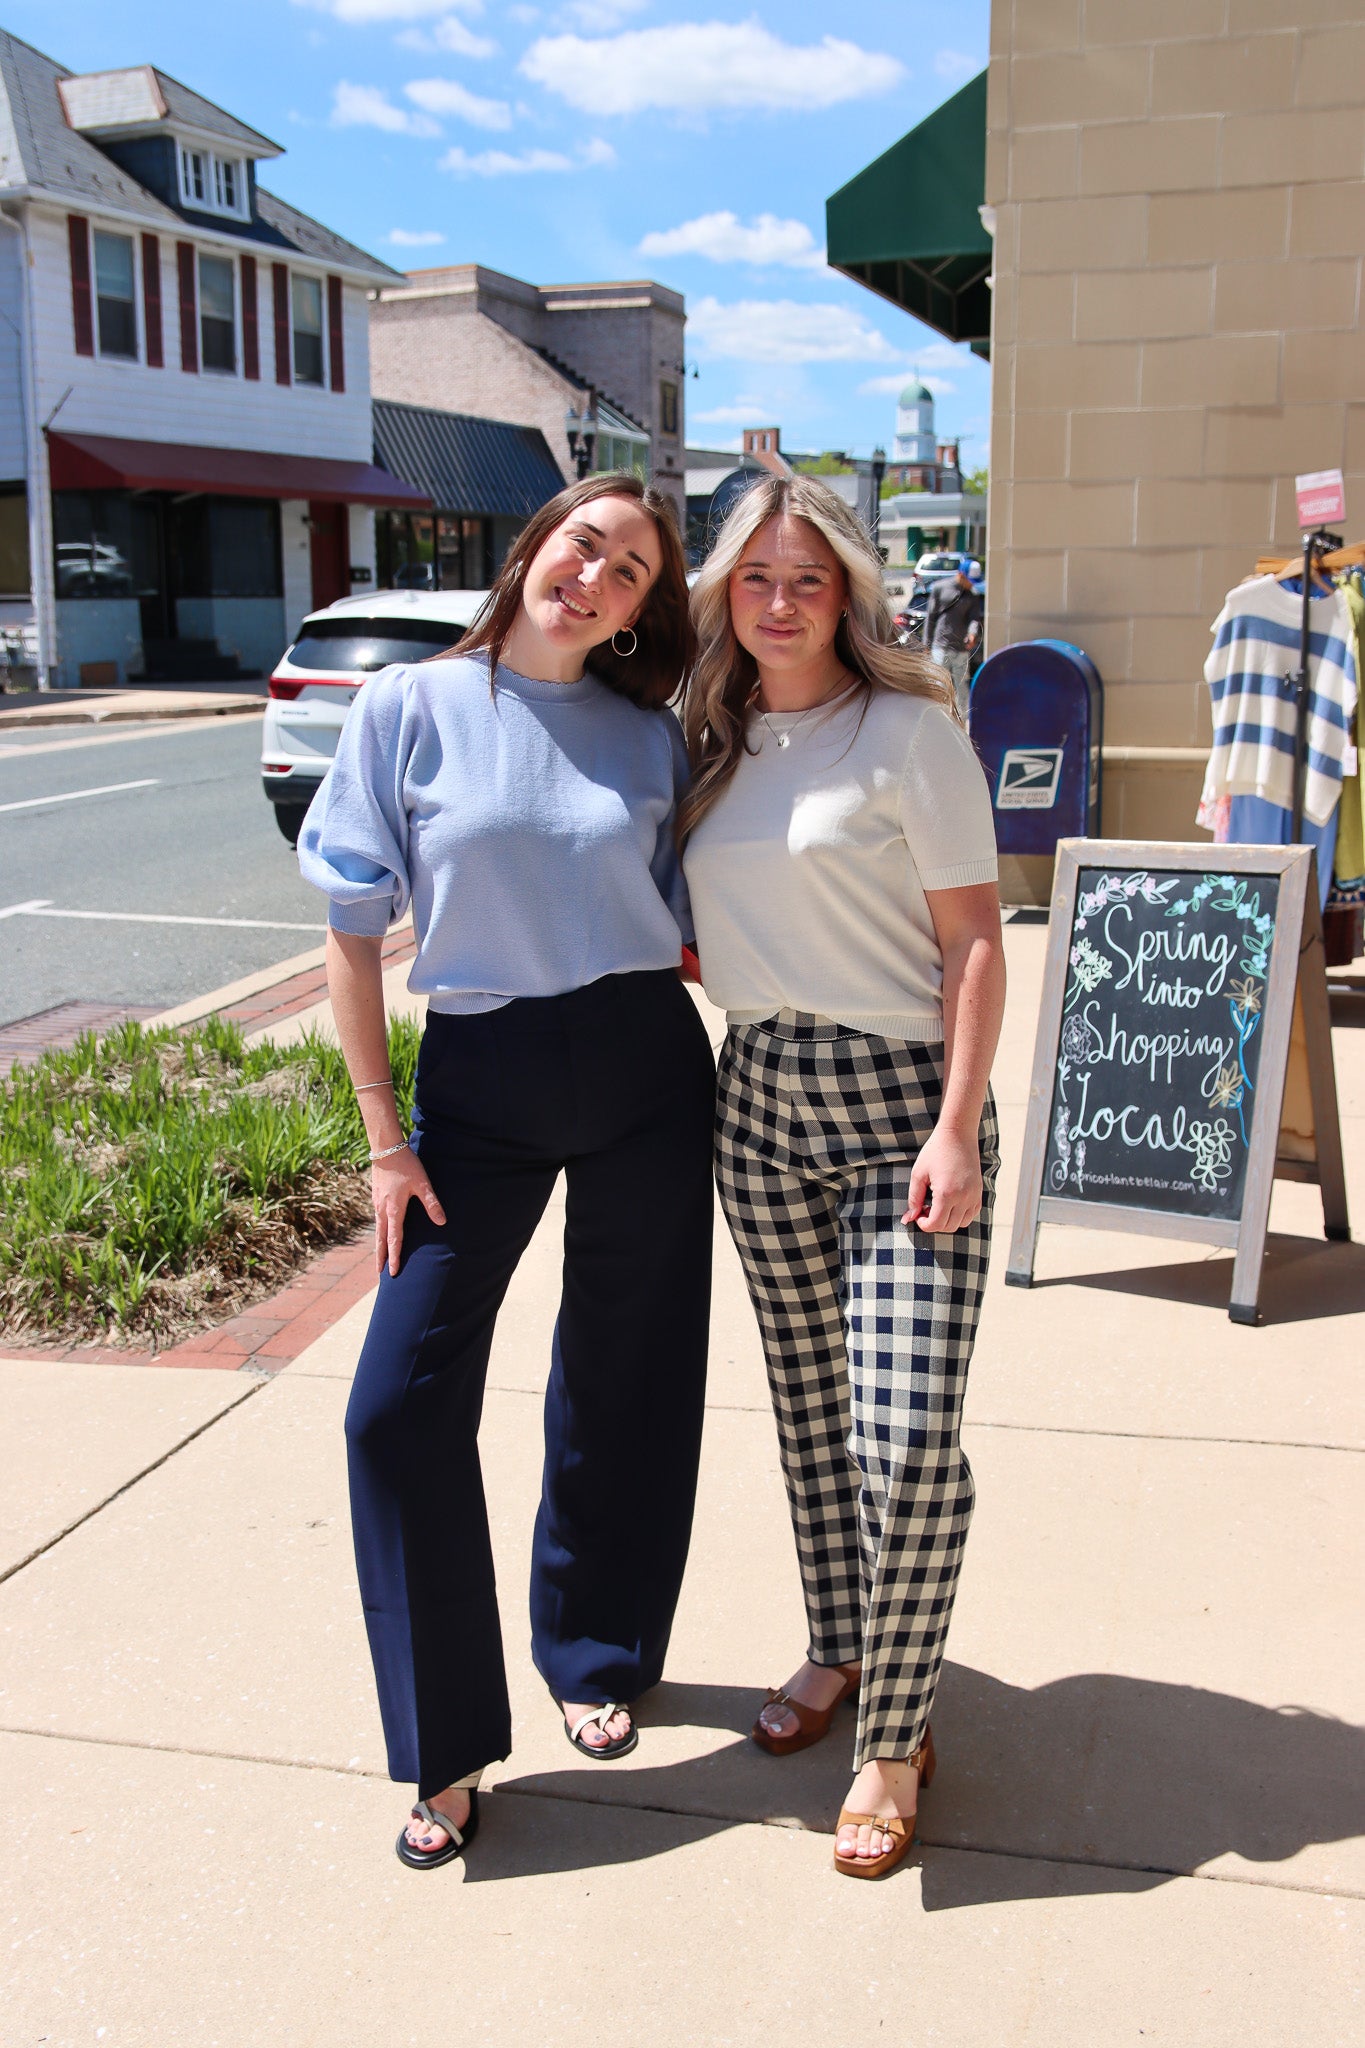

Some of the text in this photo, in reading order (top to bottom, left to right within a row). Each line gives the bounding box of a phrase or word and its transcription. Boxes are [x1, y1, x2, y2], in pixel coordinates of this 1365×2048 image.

[1104, 903, 1238, 996] Spring
[1141, 973, 1203, 1009] into
[1083, 1000, 1234, 1098] Shopping
[1068, 1071, 1194, 1151] Local
